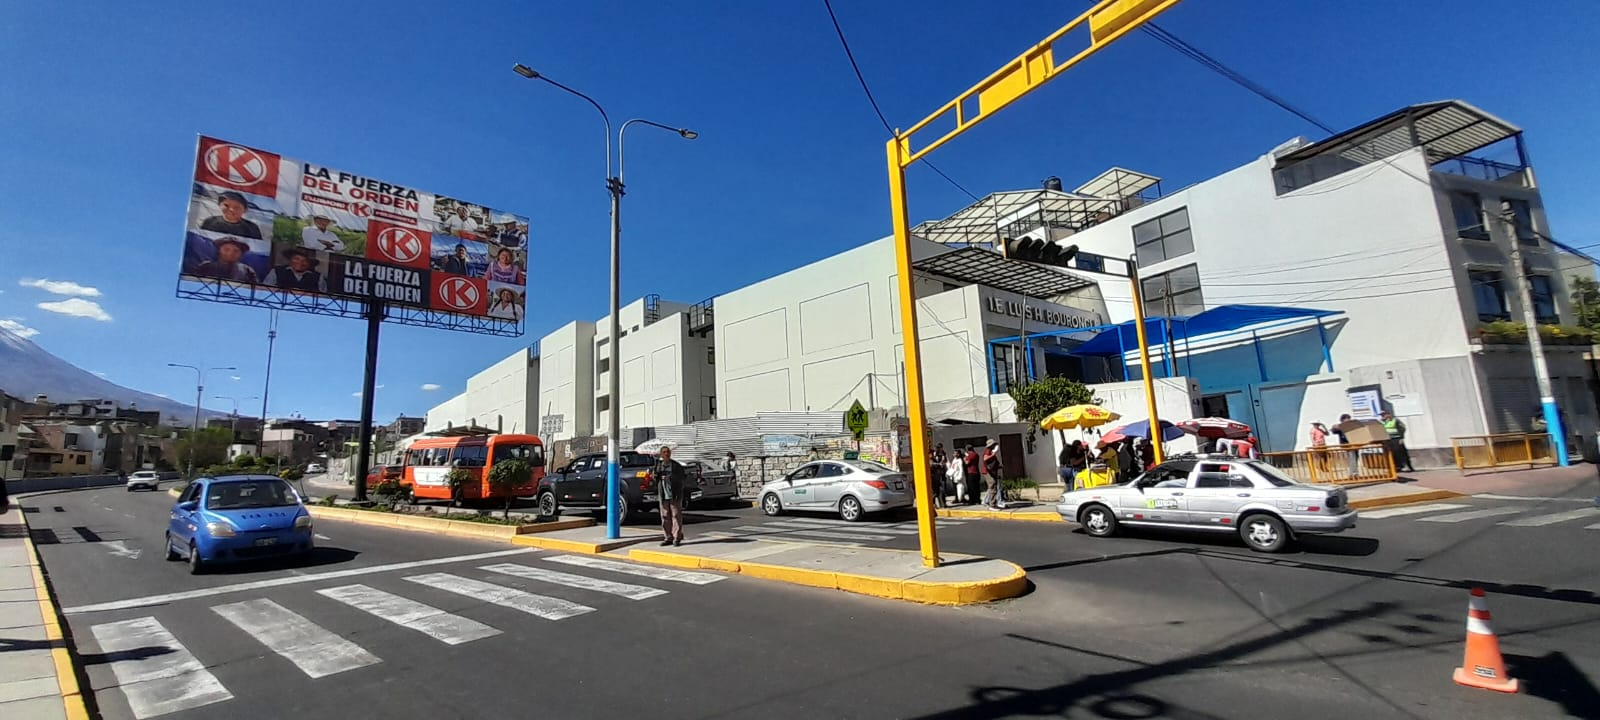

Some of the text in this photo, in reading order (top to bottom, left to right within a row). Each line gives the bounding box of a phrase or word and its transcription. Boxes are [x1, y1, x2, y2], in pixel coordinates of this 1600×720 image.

[303, 175, 342, 196] DEL
[349, 187, 418, 213] ORDEN
[304, 163, 418, 201] LA FUERZA
[344, 260, 421, 287] LA FUERZA
[343, 277, 421, 303] DEL ORDEN
